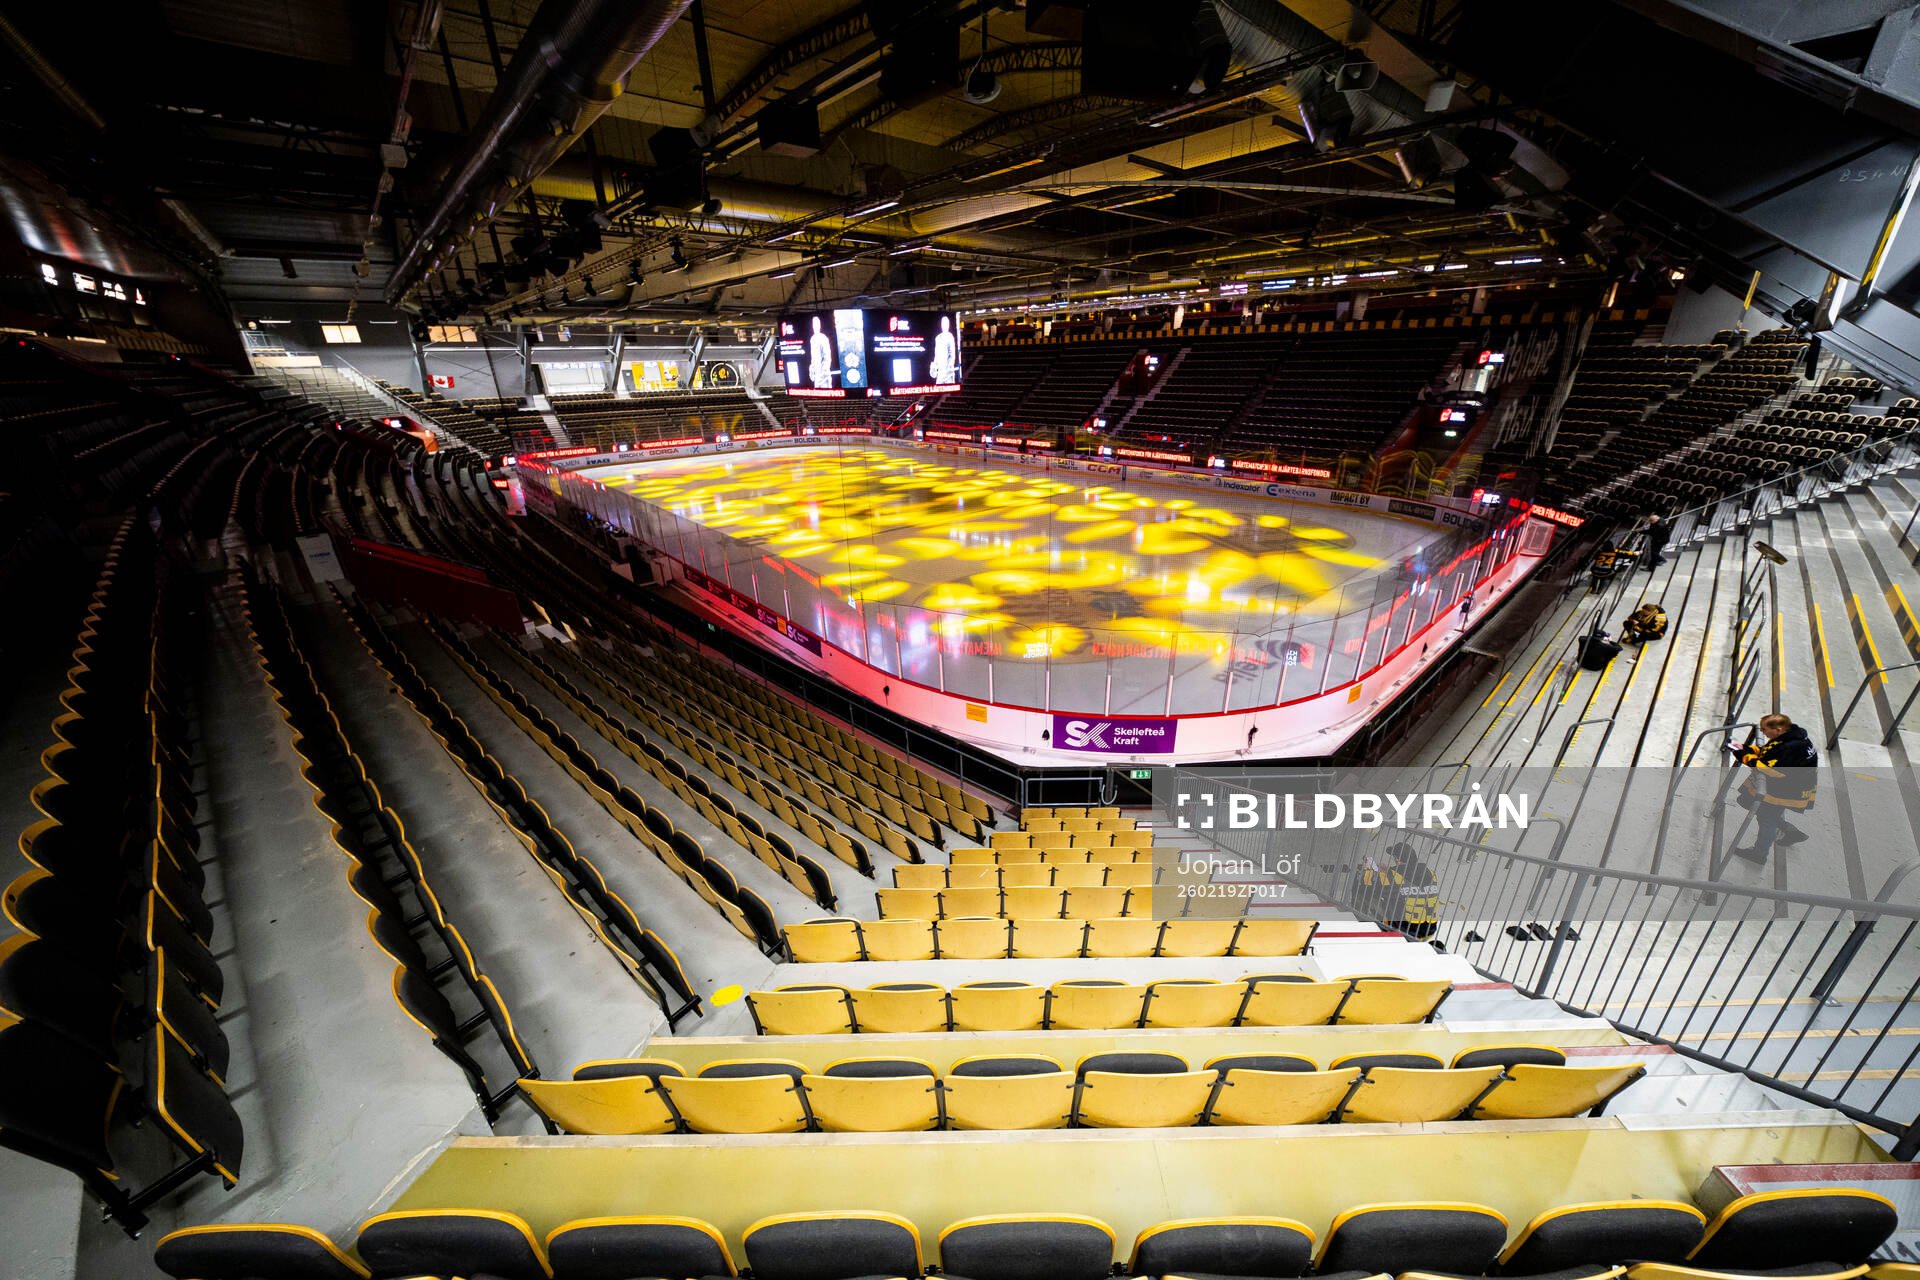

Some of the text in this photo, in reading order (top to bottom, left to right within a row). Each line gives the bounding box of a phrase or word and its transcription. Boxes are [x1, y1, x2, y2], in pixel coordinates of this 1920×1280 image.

[558, 460, 580, 468] OLMEN
[1087, 463, 1121, 475] CCM
[1223, 480, 1261, 493] Indexator
[1278, 486, 1316, 498] extena
[1330, 491, 1371, 505] IMPACT BY
[1064, 720, 1111, 750] SK
[1114, 725, 1165, 737] Skellefteå
[1113, 736, 1140, 746] Kraft
